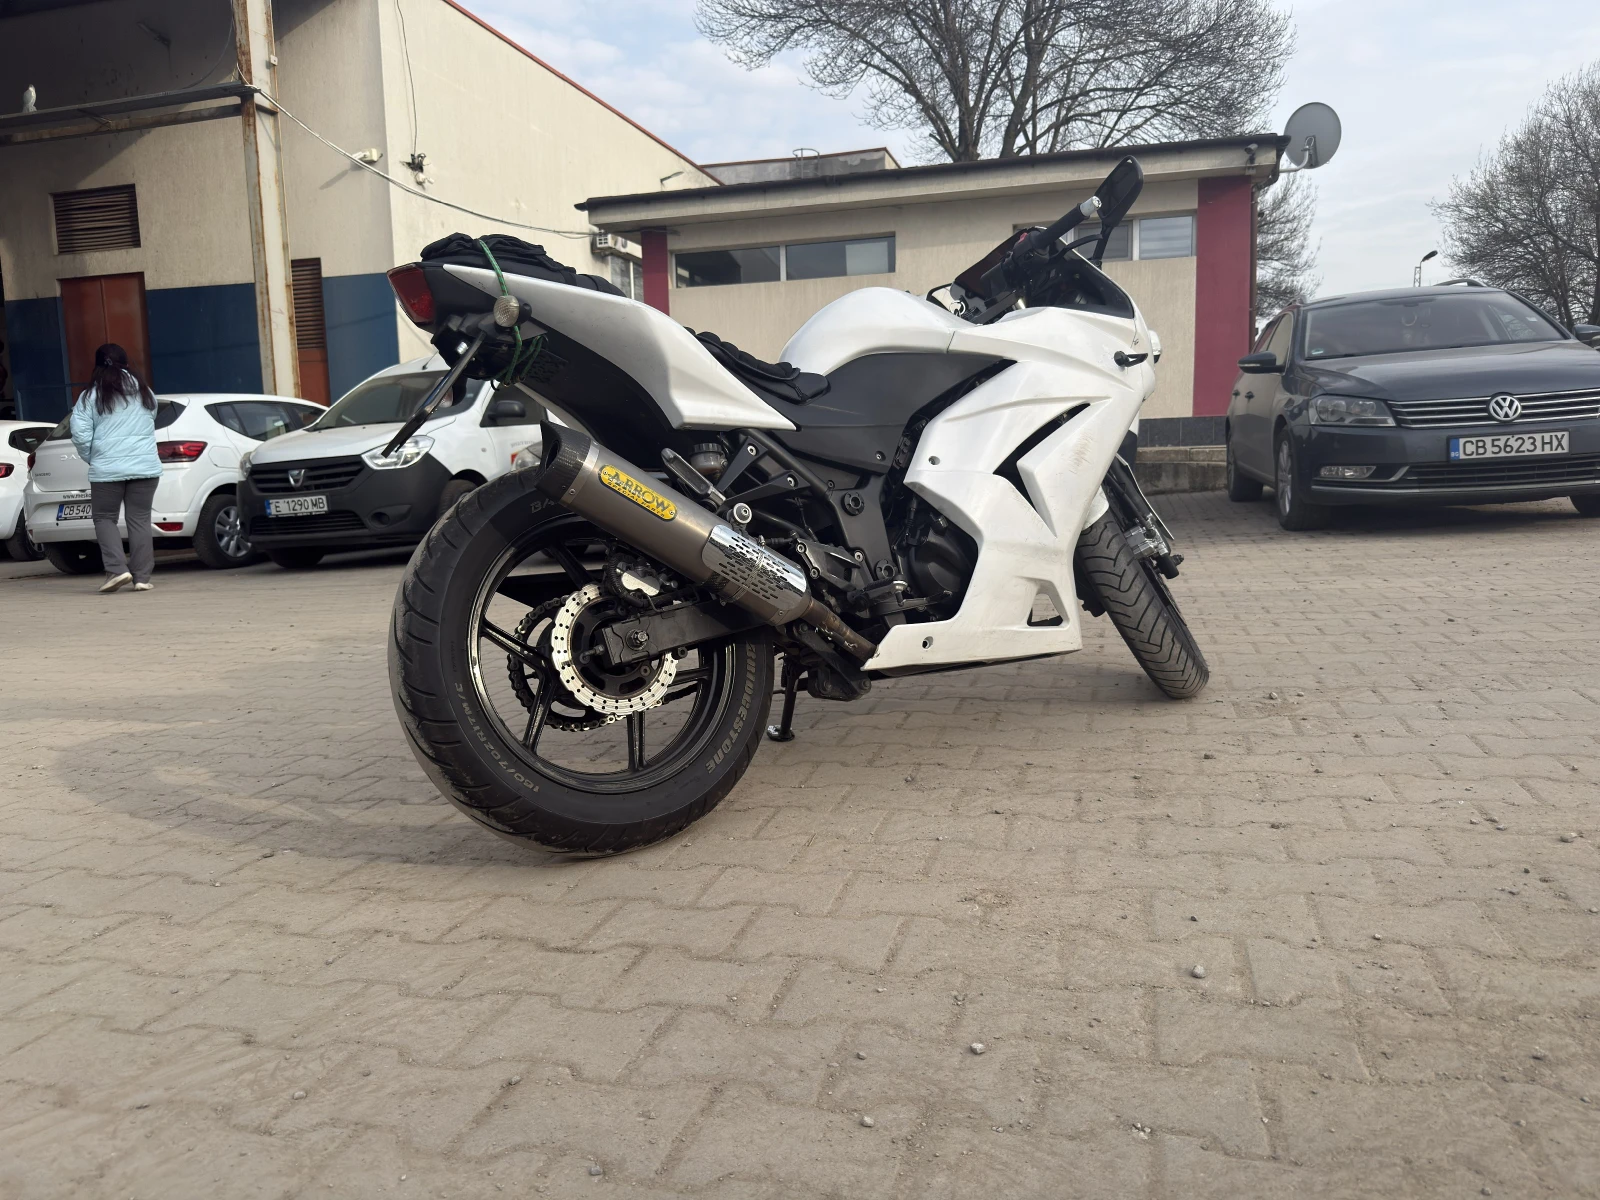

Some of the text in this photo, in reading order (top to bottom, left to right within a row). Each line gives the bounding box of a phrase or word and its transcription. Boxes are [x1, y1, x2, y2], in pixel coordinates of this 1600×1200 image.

[1463, 433, 1565, 457] CB 5623 HX
[608, 471, 671, 512] ARROW
[63, 504, 92, 516] CB 540
[274, 497, 326, 513] E 1290 MB
[705, 641, 757, 775] BRIDGESTONE
